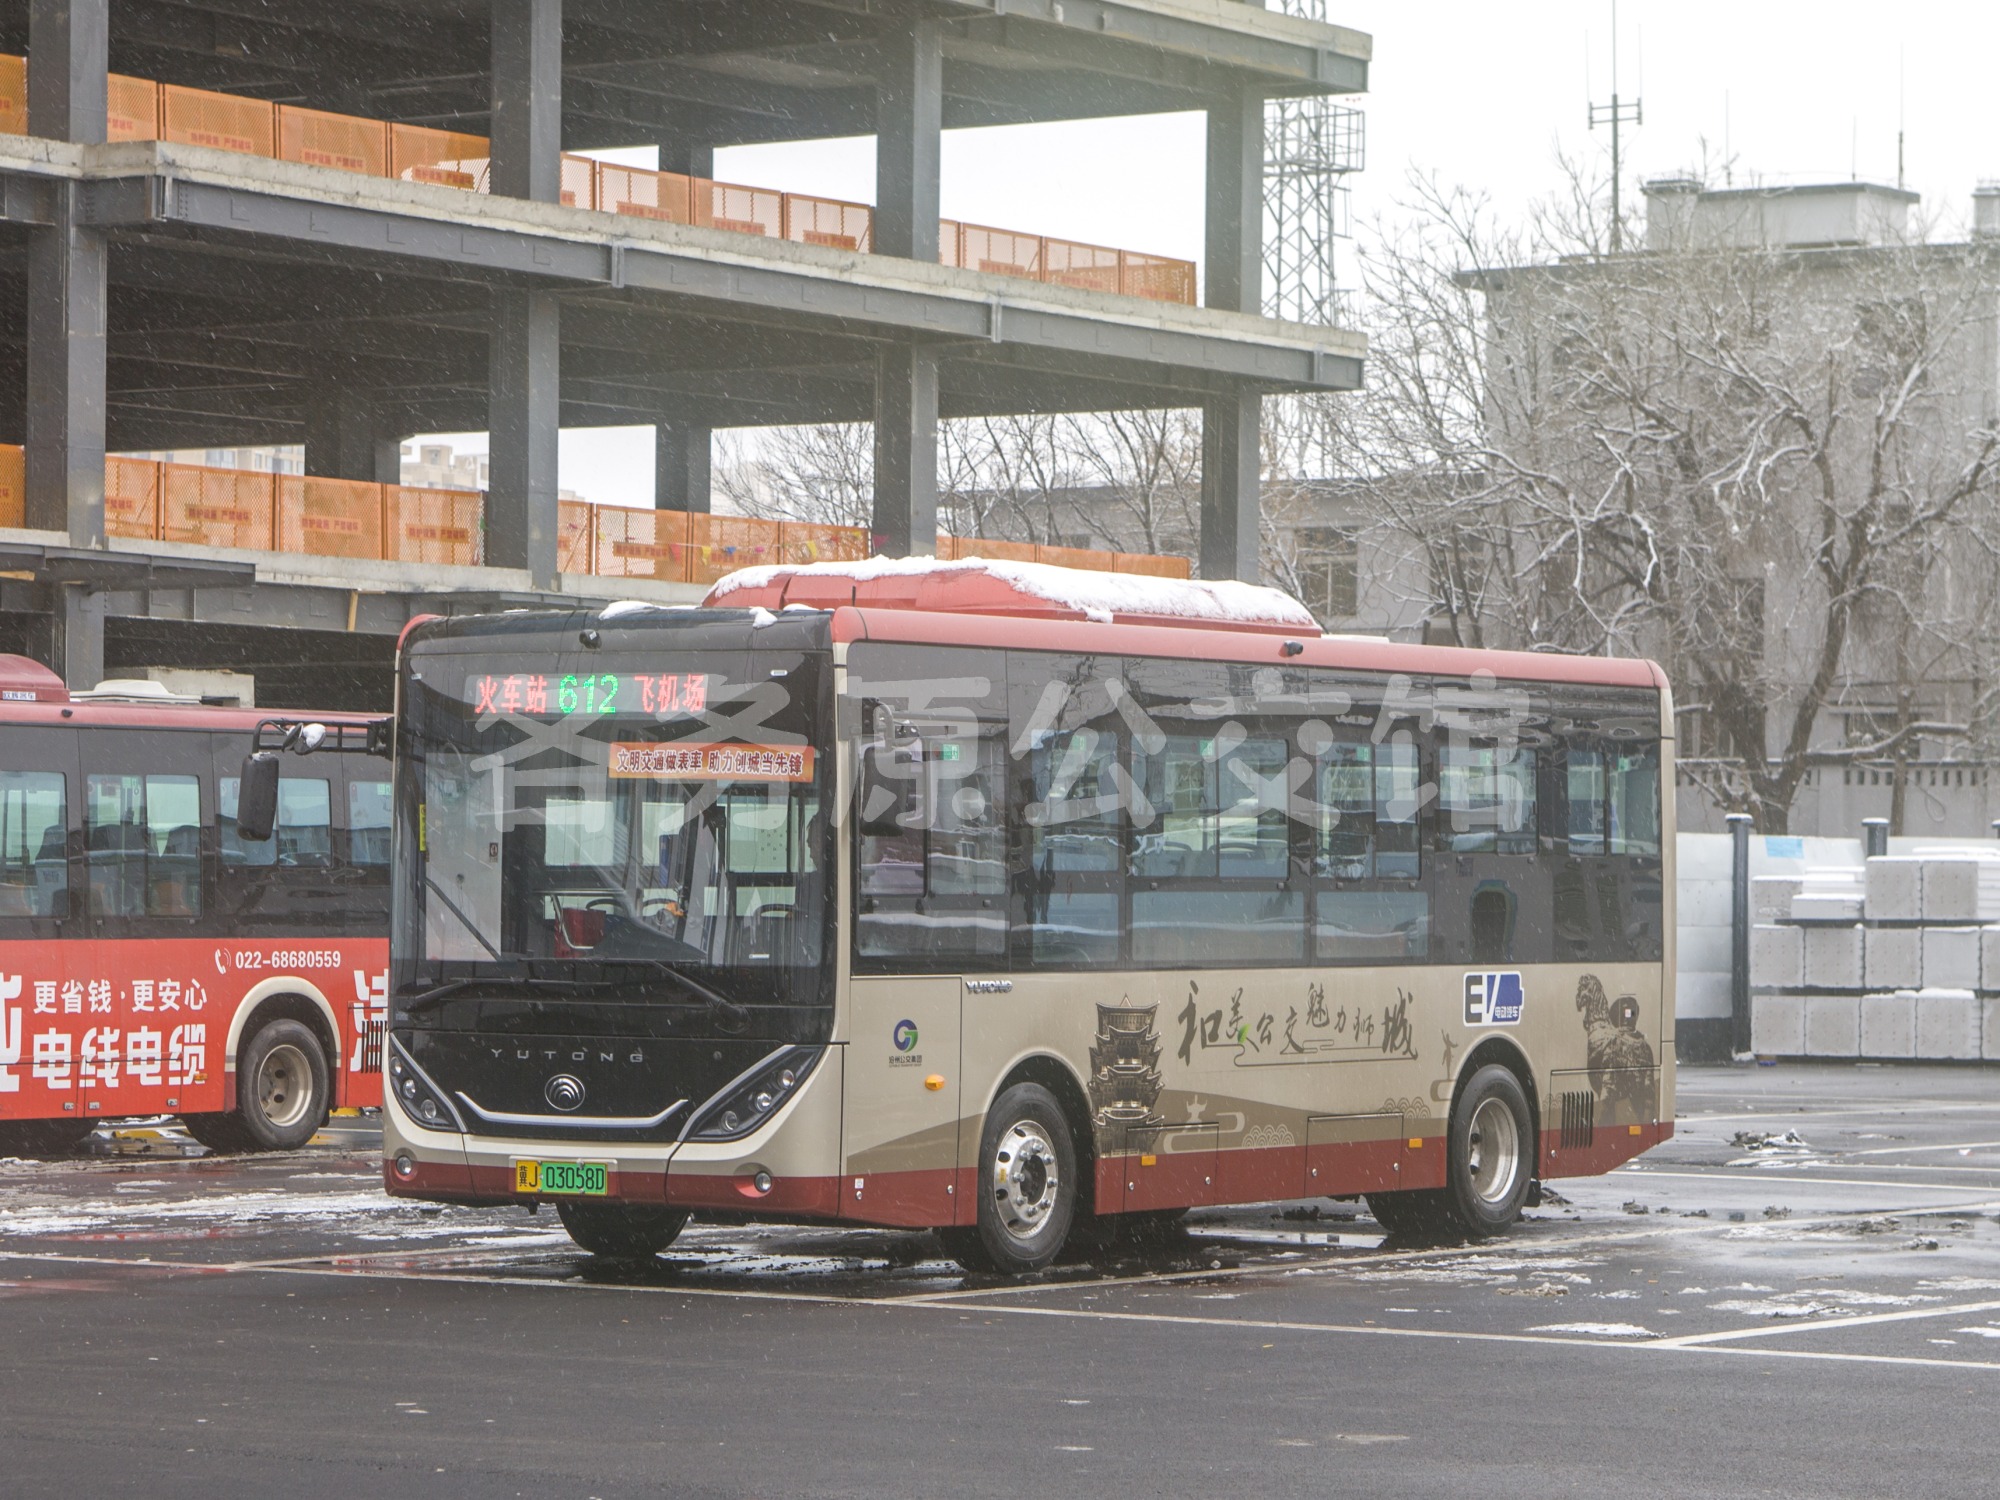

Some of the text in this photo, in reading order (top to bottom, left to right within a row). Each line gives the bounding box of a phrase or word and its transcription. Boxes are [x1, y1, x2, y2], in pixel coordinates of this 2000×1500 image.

[475, 674, 706, 714] 火车站 612 飞机场
[616, 751, 804, 776] 文明交通做表率 助力创城当先锋
[235, 951, 341, 969] 022-68680559
[966, 980, 1013, 995] YUTONG
[33, 1024, 206, 1088] 电线电缆
[491, 1049, 643, 1063] YUTONG
